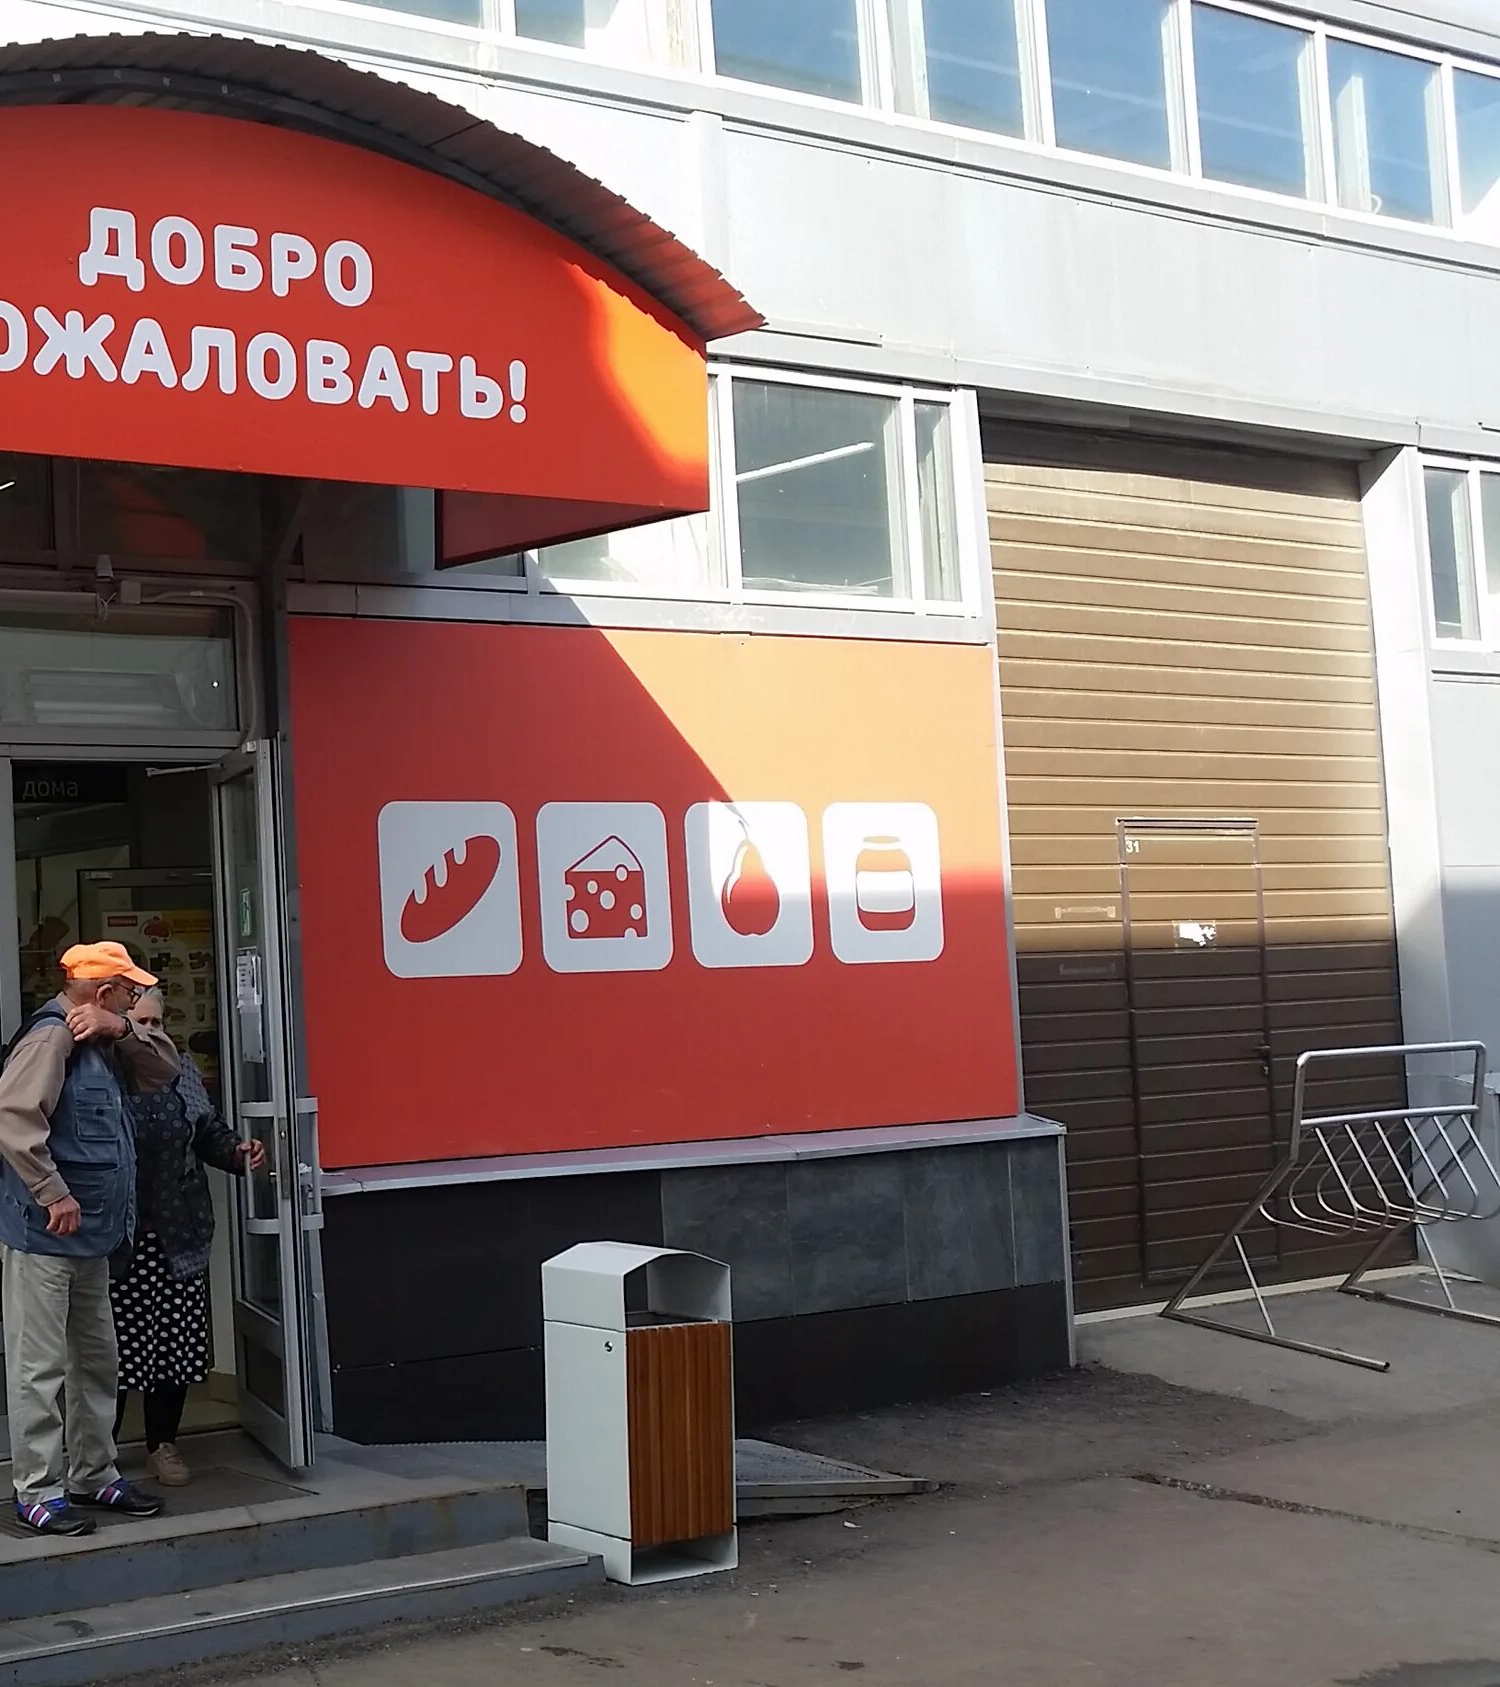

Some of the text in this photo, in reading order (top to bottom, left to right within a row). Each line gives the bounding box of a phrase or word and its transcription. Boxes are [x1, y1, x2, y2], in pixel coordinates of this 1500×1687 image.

[78, 206, 373, 307] ДОБРО
[23, 780, 78, 800] дома
[1126, 840, 1140, 853] 31
